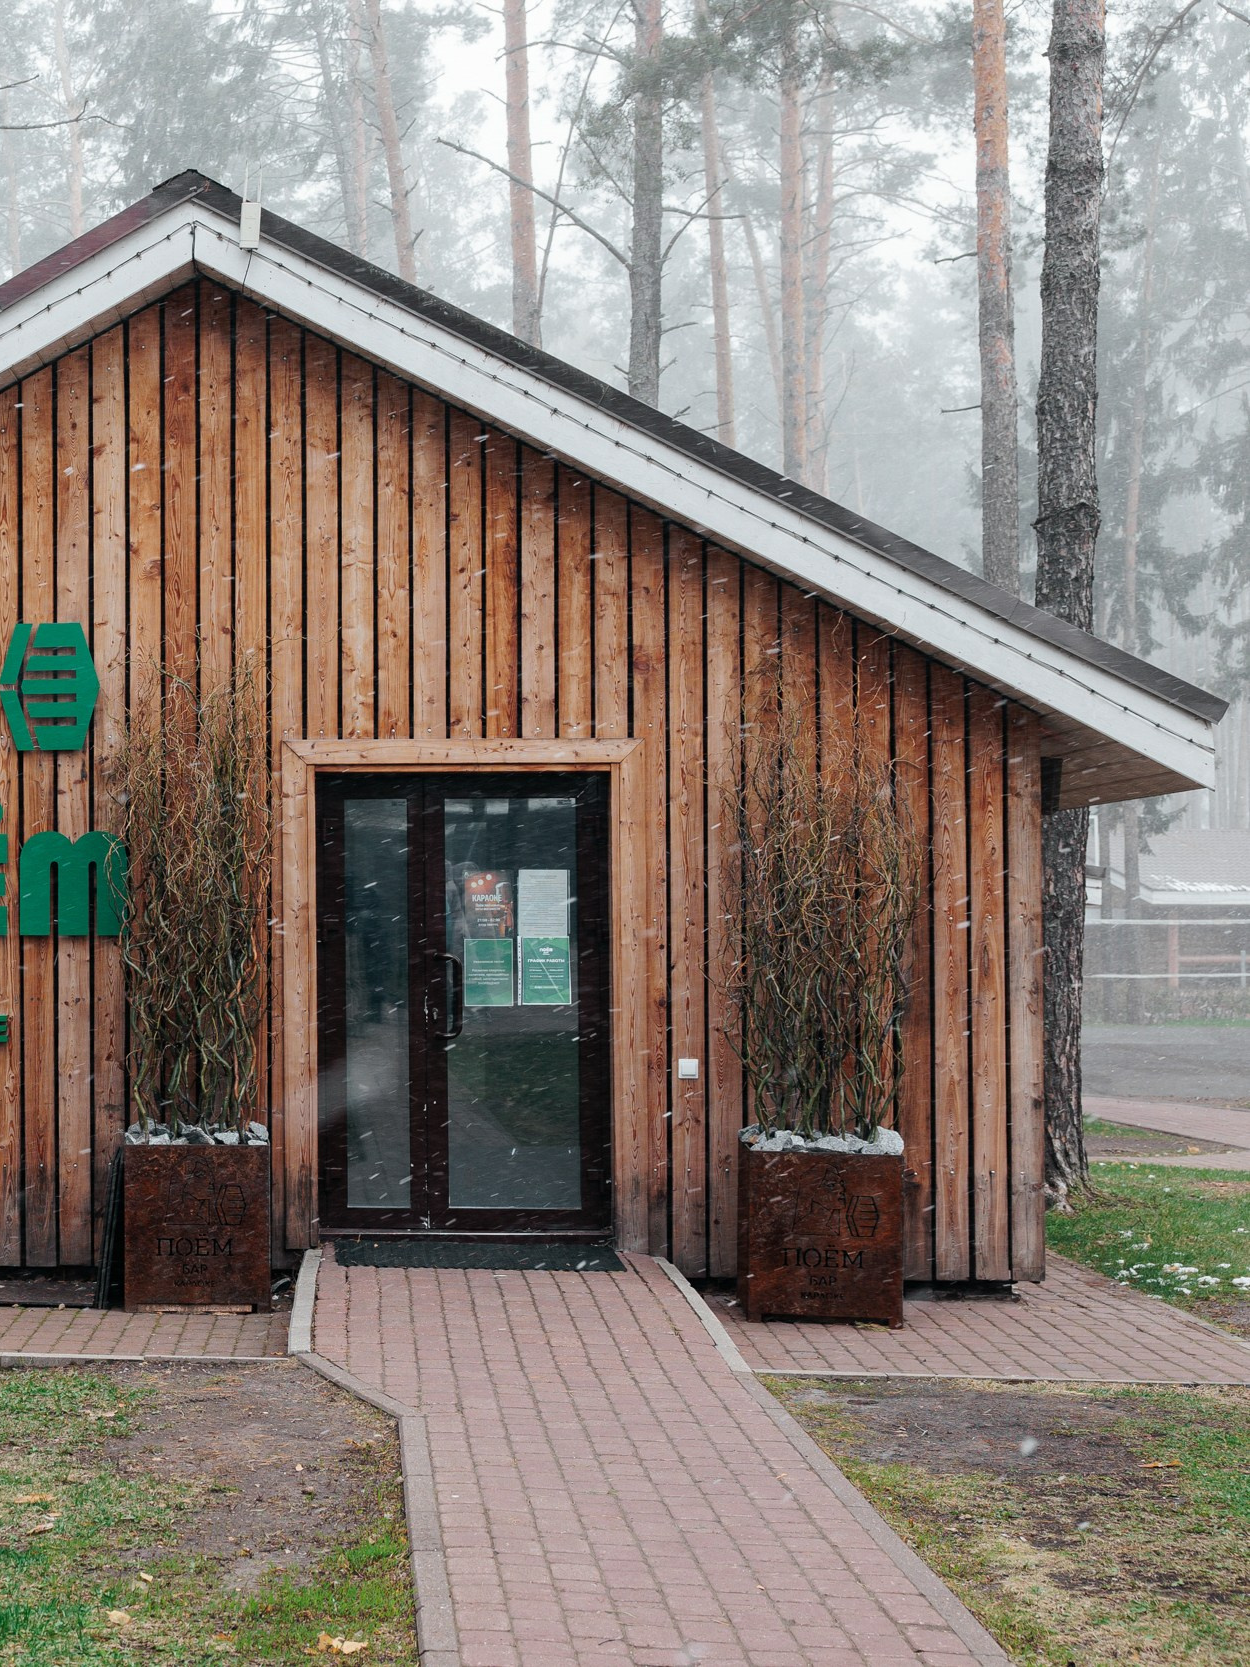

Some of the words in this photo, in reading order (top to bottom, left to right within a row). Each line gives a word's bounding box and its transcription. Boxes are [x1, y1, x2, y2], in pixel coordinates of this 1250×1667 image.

[156, 1234, 234, 1257] ПОЁМ
[782, 1245, 865, 1269] ПОЁМ
[182, 1264, 208, 1275] БАР
[809, 1275, 837, 1286] БАР
